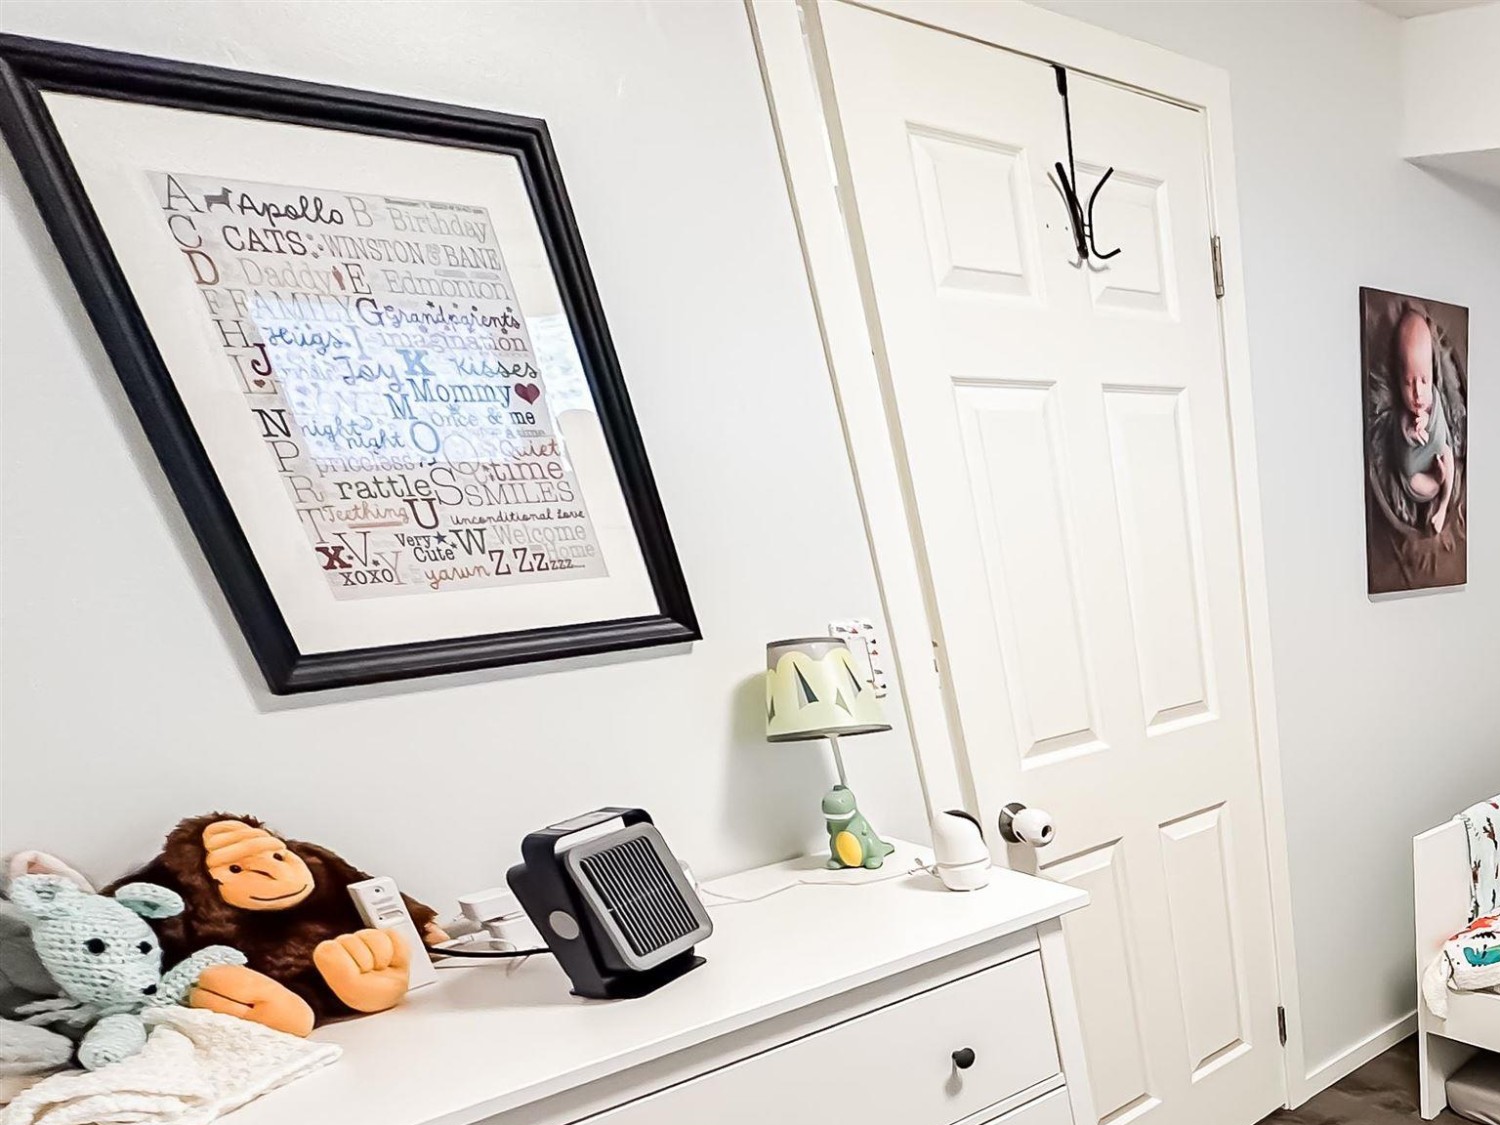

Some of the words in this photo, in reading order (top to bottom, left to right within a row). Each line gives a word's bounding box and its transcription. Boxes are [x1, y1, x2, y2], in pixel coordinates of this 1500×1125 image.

[162, 174, 205, 213] A
[237, 193, 344, 227] Apollo
[345, 196, 373, 227] B
[386, 206, 487, 243] Birthday
[168, 214, 202, 249] C
[180, 249, 219, 285] D
[321, 234, 425, 265] WINSTON
[442, 244, 502, 271] BANE
[236, 257, 332, 296] Daddy
[342, 263, 372, 295] E
[381, 269, 513, 301] Edmonton
[201, 288, 222, 314] F
[226, 288, 355, 322] FAMILY
[356, 297, 385, 327] G
[212, 319, 254, 348] H
[377, 330, 528, 354] imagination
[251, 343, 272, 376] J
[333, 355, 405, 392] Joy
[396, 349, 436, 376] K
[384, 393, 418, 420] M
[406, 378, 511, 408] Mommy
[251, 409, 292, 437] N
[301, 416, 373, 442] night
[509, 411, 536, 425] me
[346, 429, 404, 450] night
[410, 420, 440, 454] O
[265, 440, 300, 472] P
[310, 454, 415, 478] priceless
[489, 460, 564, 482] time
[284, 475, 325, 503] R
[334, 474, 432, 500] rattle
[430, 467, 463, 506] S
[465, 481, 575, 506] SMILES
[297, 508, 330, 544] T
[323, 501, 409, 524] Teething
[402, 498, 439, 529] U
[332, 531, 371, 567] V
[394, 533, 431, 549] Very
[449, 528, 487, 555] W
[493, 524, 586, 546] Welcome
[413, 547, 454, 563] Cute
[545, 542, 595, 560] Home
[373, 551, 407, 585] Y
[424, 564, 490, 589] yawn
